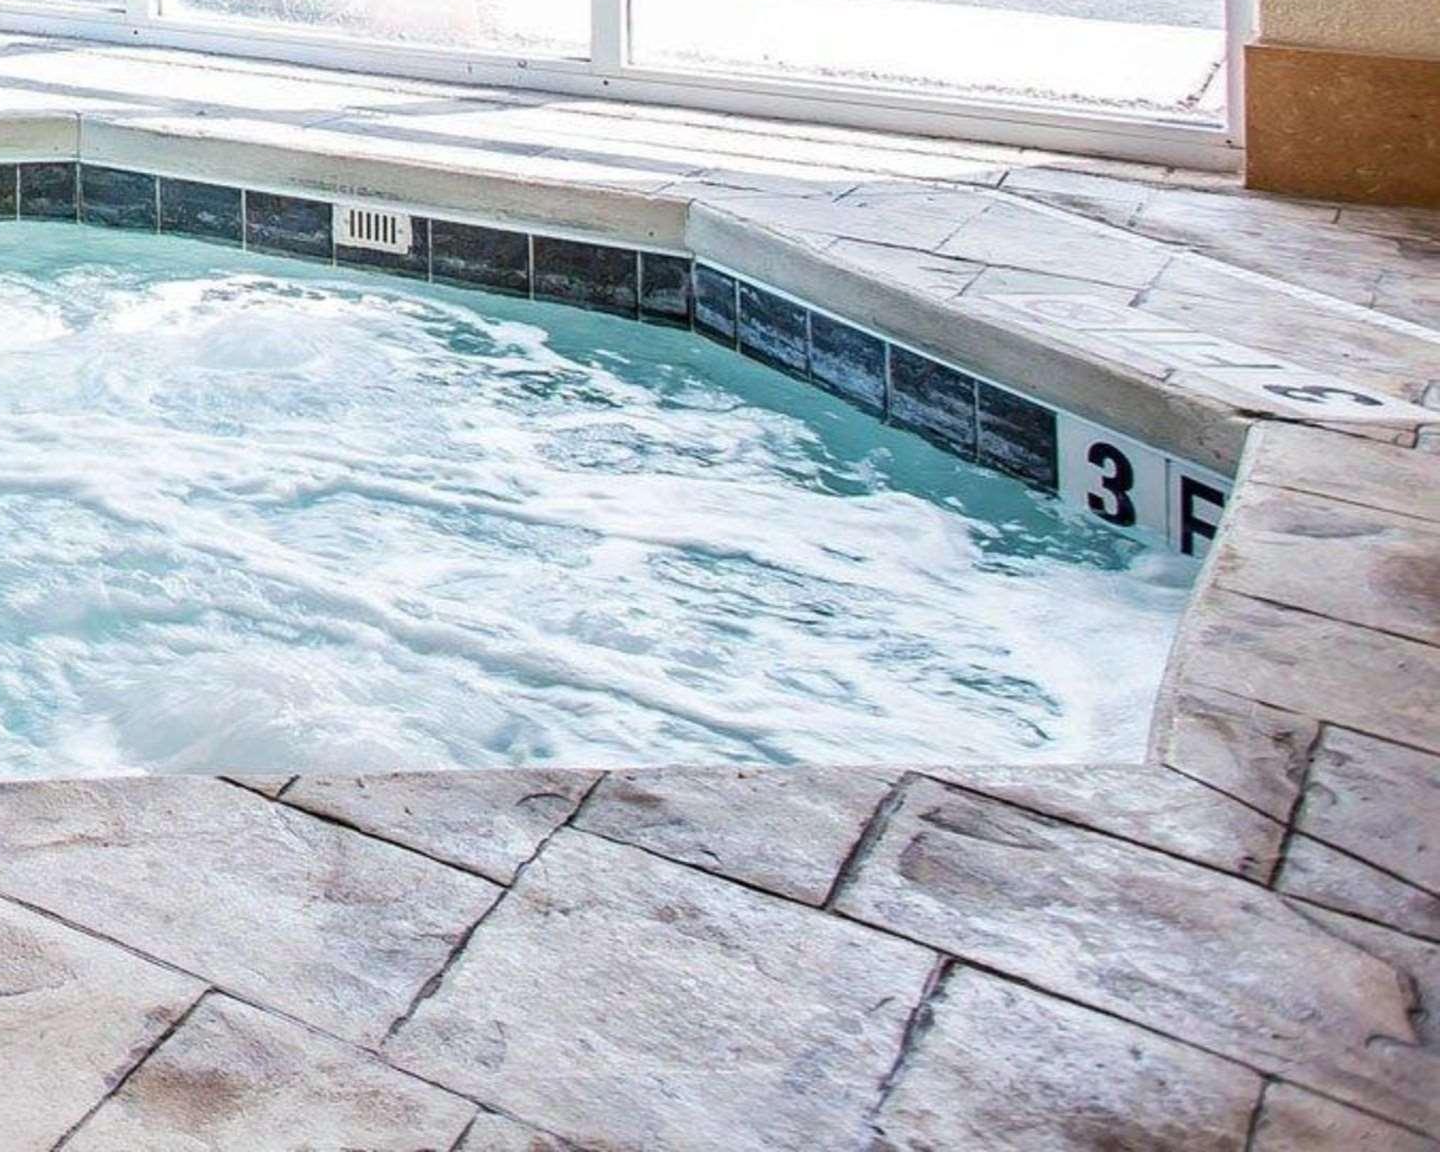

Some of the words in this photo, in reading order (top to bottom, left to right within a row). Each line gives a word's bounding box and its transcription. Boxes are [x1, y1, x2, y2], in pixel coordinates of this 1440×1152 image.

[1262, 383, 1385, 407] 3
[1087, 442, 1136, 528] 3
[1180, 475, 1225, 557] F
